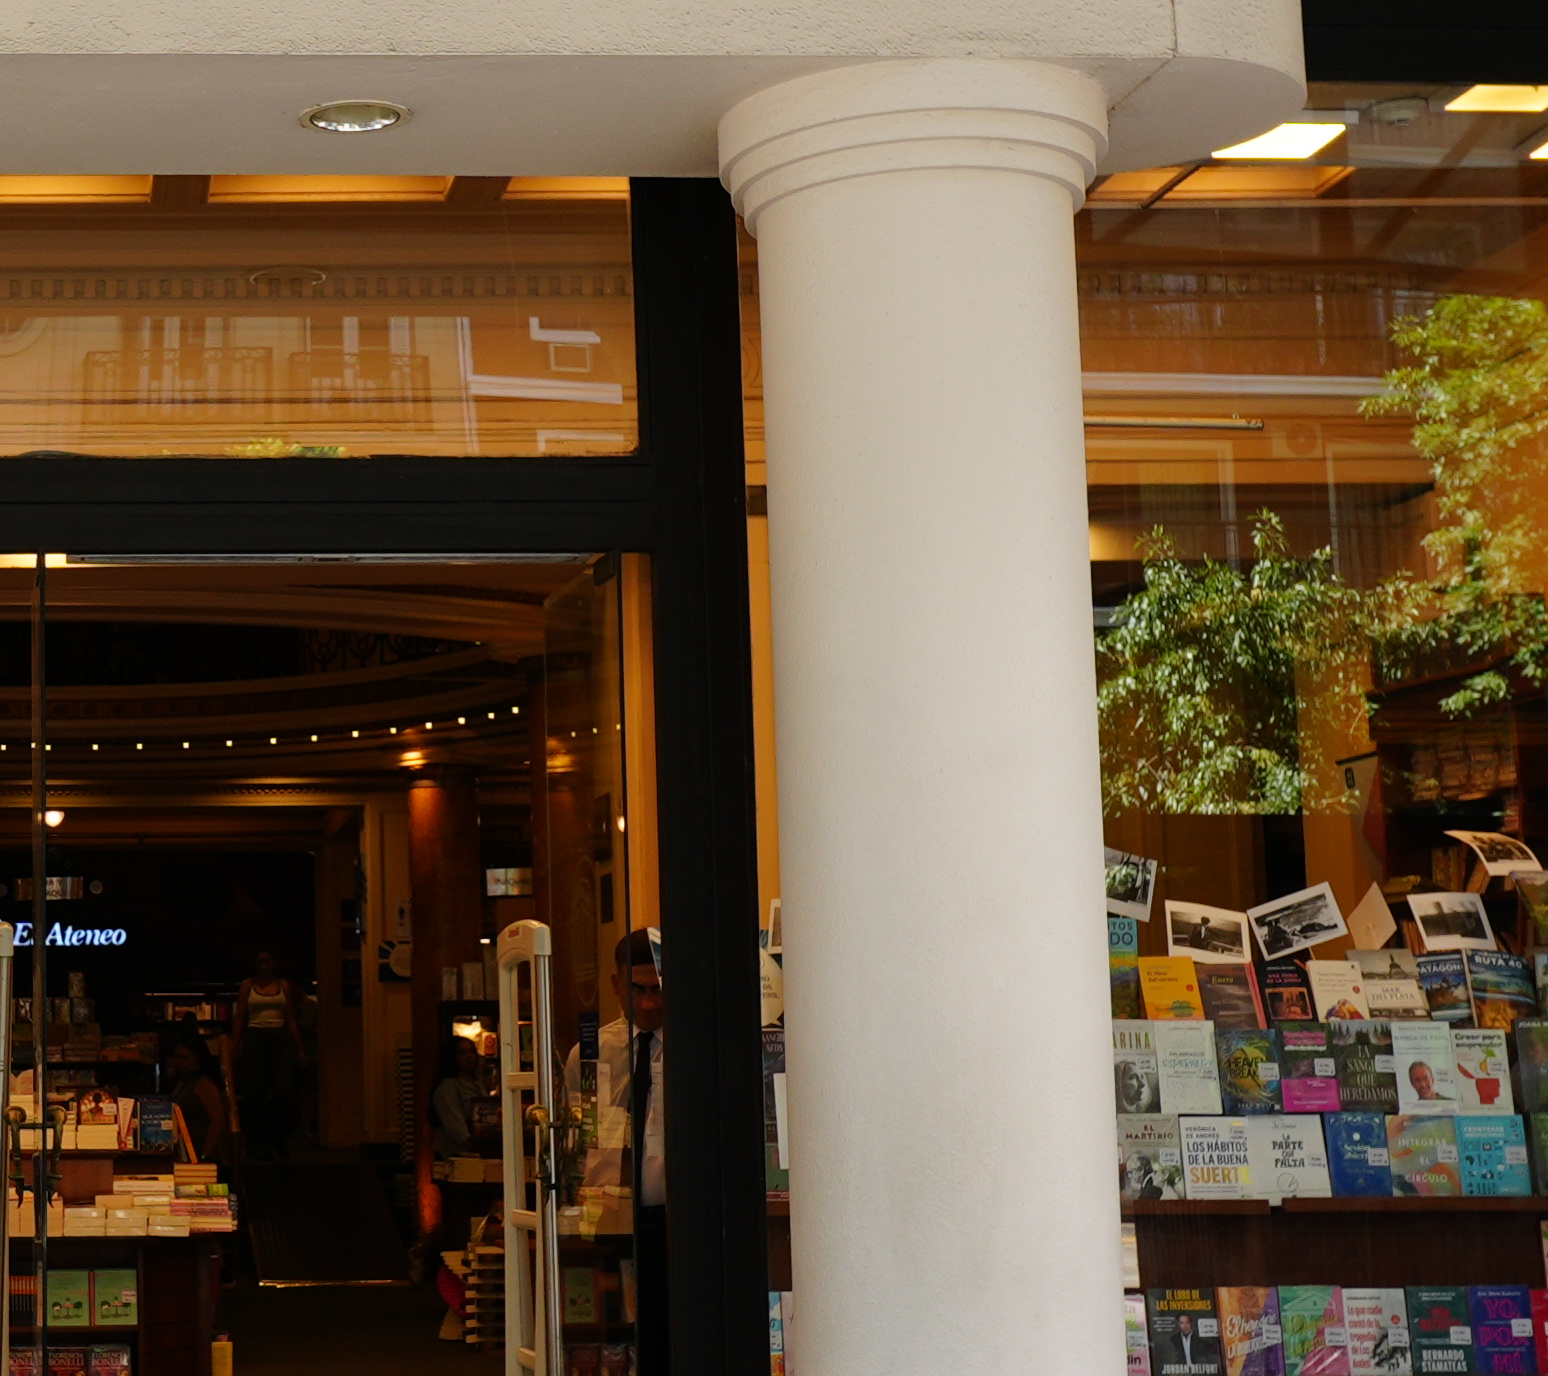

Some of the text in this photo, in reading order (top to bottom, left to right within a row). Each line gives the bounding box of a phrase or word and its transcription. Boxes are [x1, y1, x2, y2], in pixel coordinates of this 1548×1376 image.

[46, 921, 128, 947] Ateneo
[1186, 1137, 1249, 1153] LOS HÁBITOS
[1188, 1153, 1249, 1166] DE LA BUENA
[1190, 1166, 1253, 1185] SUERTE
[1421, 1349, 1465, 1361] BERNARDO
